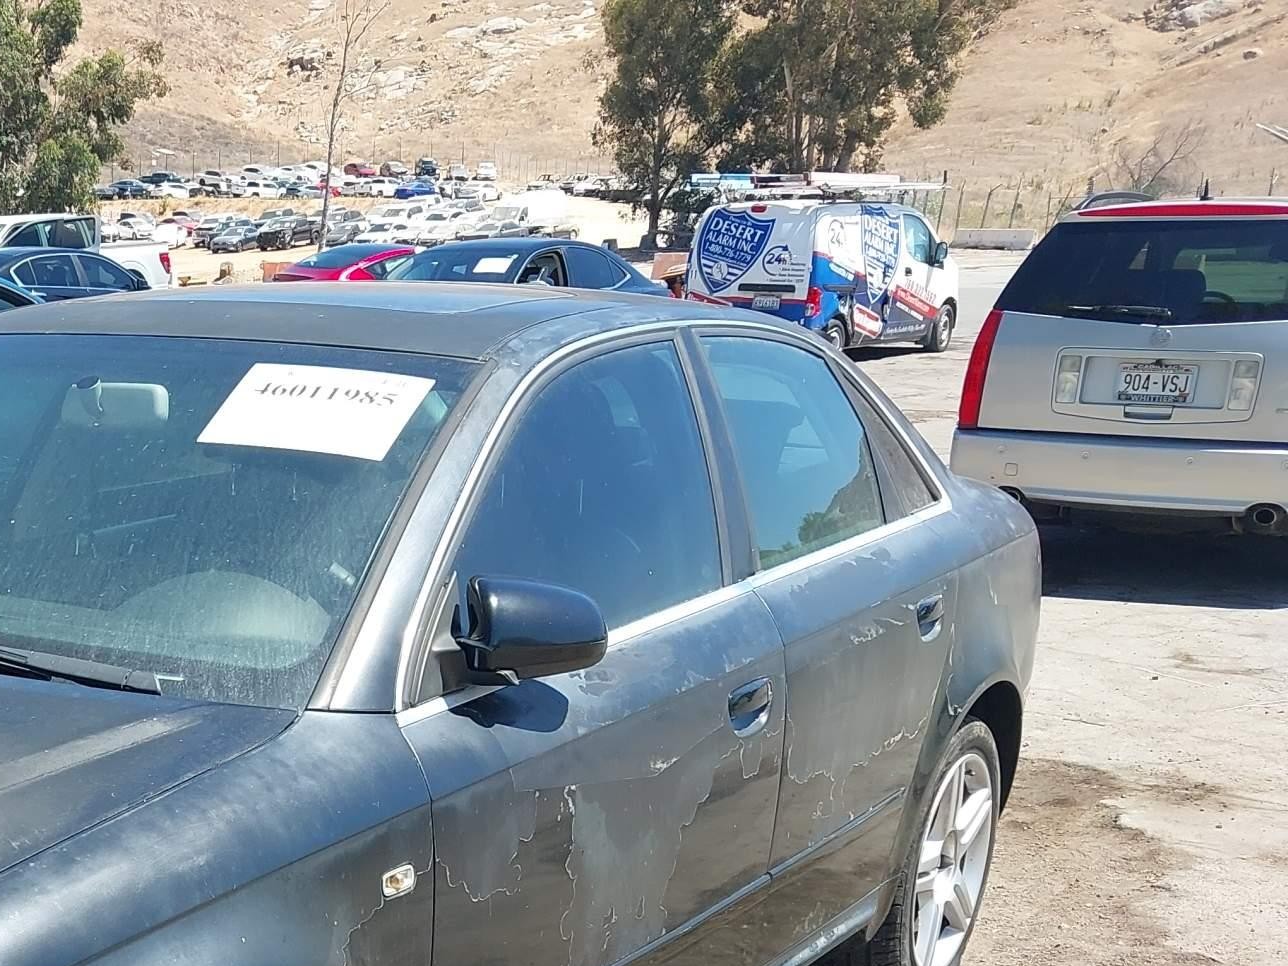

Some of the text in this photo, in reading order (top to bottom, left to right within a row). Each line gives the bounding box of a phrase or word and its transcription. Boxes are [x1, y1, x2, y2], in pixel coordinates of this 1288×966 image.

[705, 230, 737, 249] ALARM
[710, 217, 765, 243] DESERT
[254, 381, 399, 407] 46011985
[1123, 373, 1190, 393] 904-VSJ
